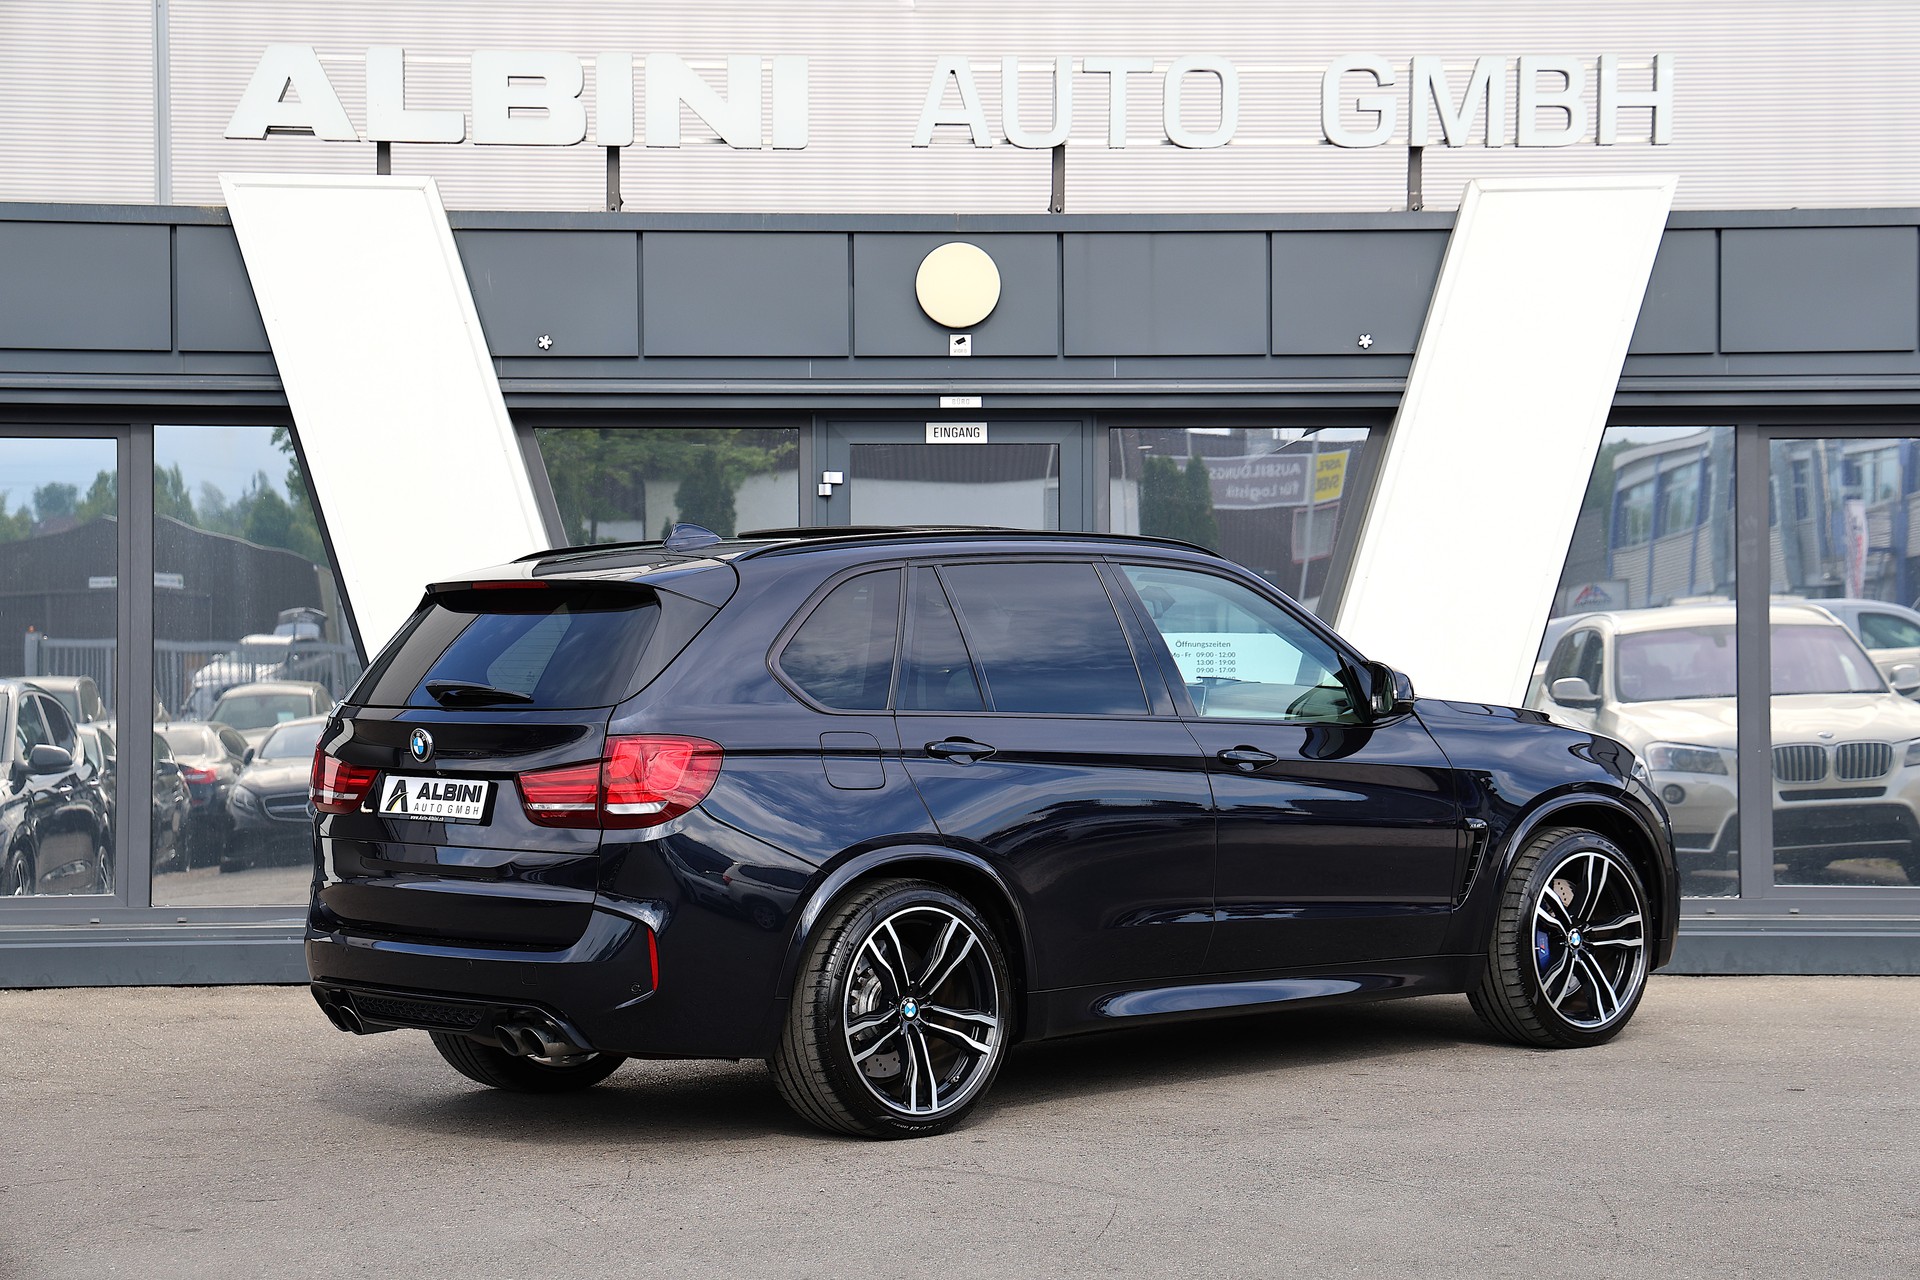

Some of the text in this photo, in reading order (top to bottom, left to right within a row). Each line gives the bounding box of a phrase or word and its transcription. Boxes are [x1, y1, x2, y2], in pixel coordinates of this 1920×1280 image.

[224, 43, 1675, 150] ALBINI AUTO GMBH
[933, 427, 980, 438] EINGANG
[1175, 640, 1231, 649] Öffnungszeiten
[416, 782, 483, 802] ALBINI
[414, 802, 479, 815] AUTO GMBH
